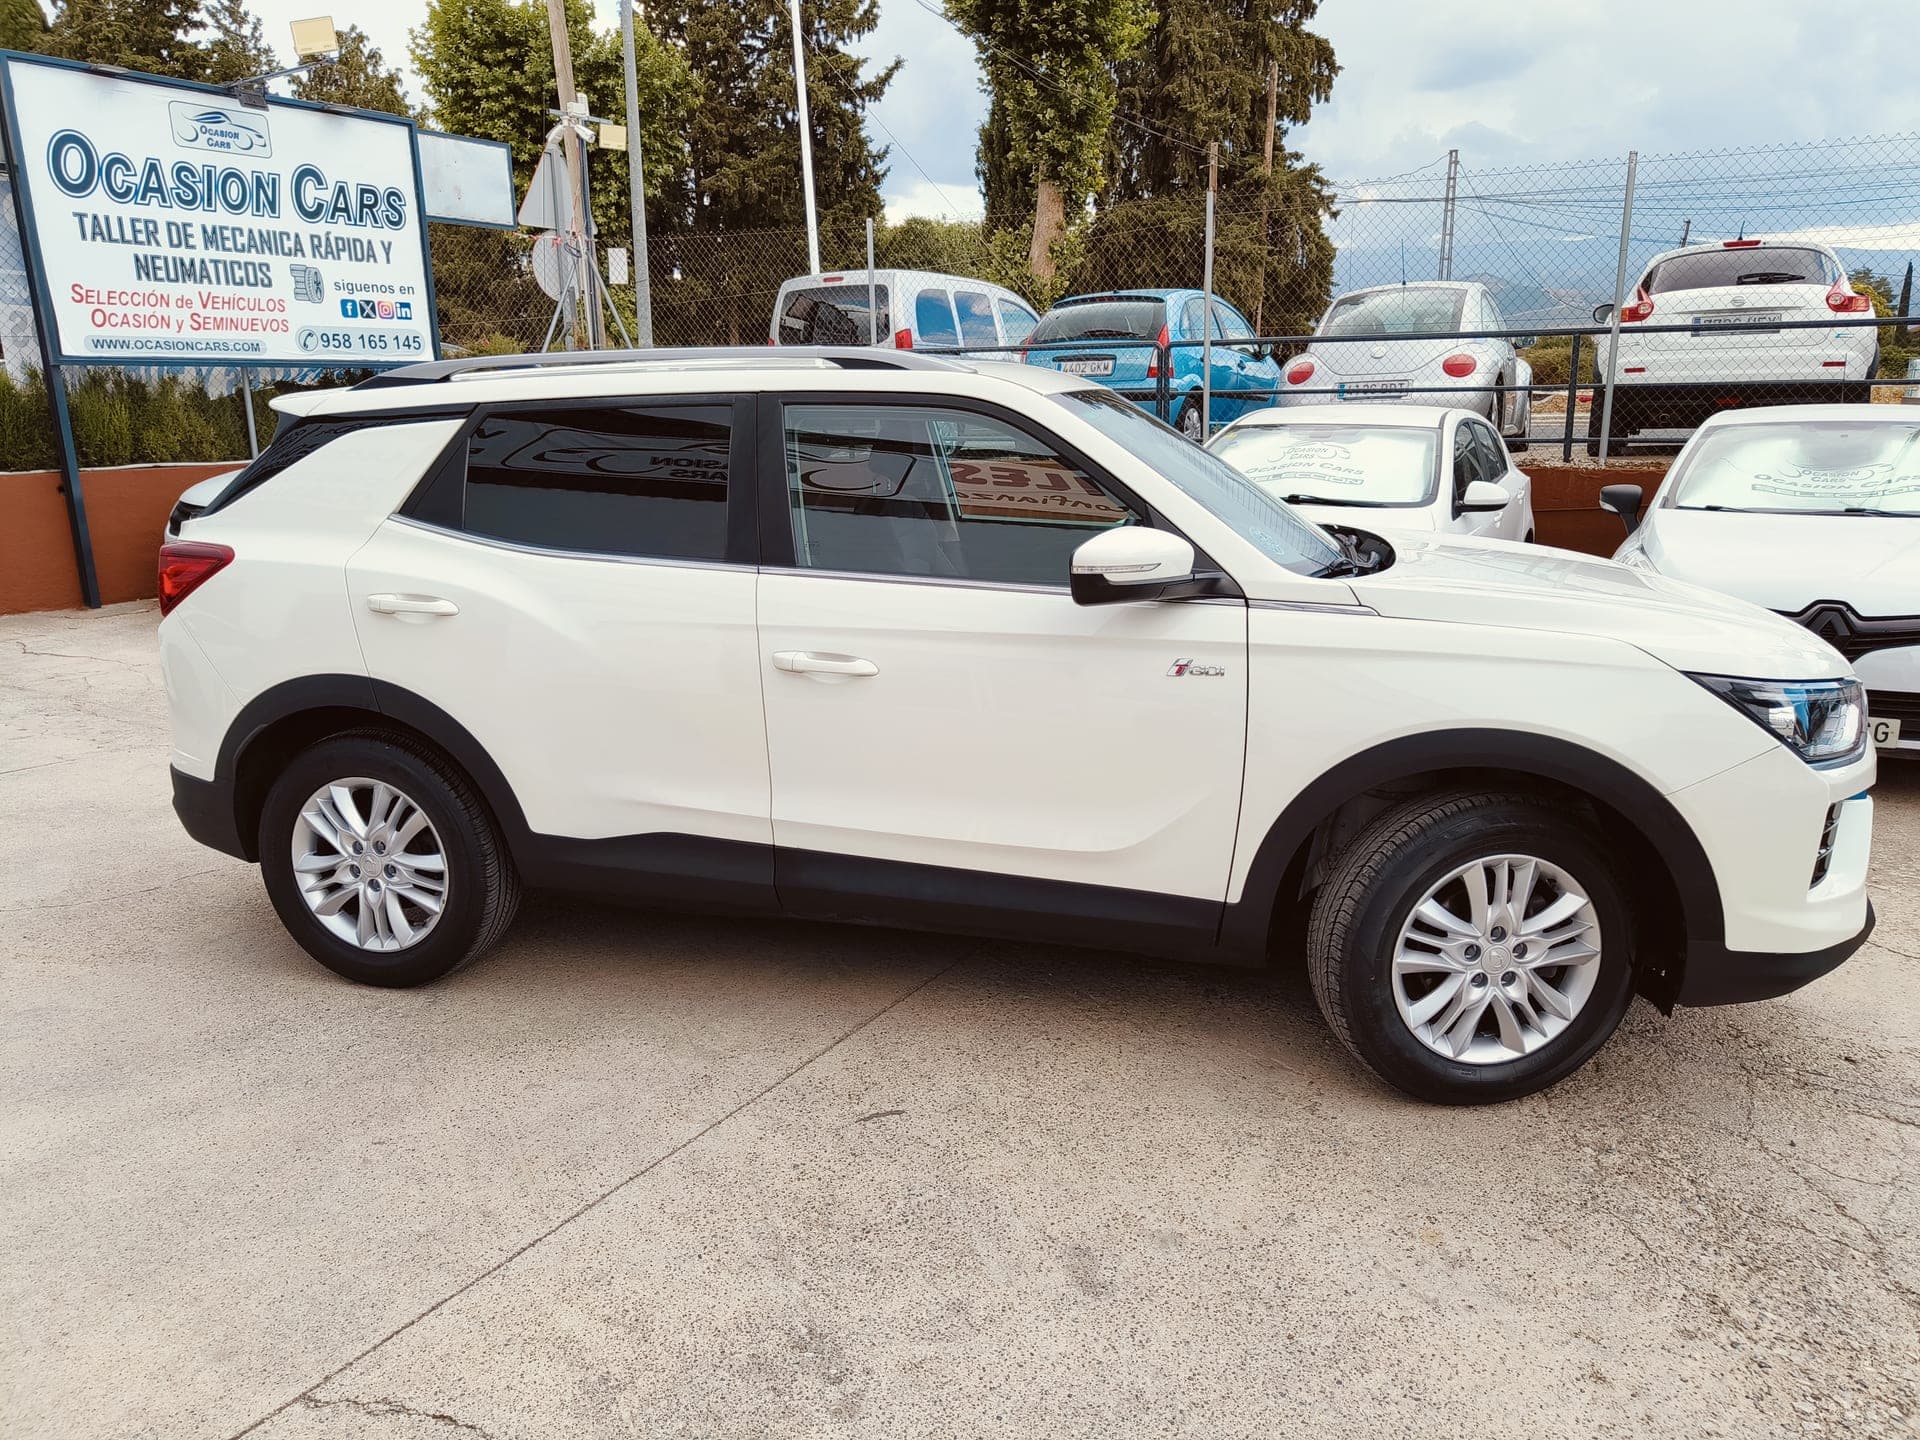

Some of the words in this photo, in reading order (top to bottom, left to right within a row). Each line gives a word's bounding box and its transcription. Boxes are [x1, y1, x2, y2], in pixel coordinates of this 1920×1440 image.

[200, 125, 239, 140] OCASION
[207, 138, 231, 149] CARS
[47, 128, 281, 218] OCASION
[291, 163, 407, 231] CARS
[72, 211, 161, 247] TALLER
[166, 221, 196, 250] DE
[201, 224, 307, 258] MECANICA
[310, 230, 378, 264] RÁPIDA
[380, 240, 393, 264] Y
[133, 253, 273, 288] NEUMATICOS
[71, 283, 170, 308] SELECCIÓN
[175, 294, 194, 309] de
[198, 291, 286, 312] VEHÍCULOS
[399, 284, 415, 296] en
[91, 308, 171, 329] OCASIÓN
[176, 318, 185, 333] y
[190, 312, 289, 332] SEMINUEVOS
[92, 338, 261, 352] WWW.OCASIONCARS.COM
[321, 333, 352, 349] 958
[359, 334, 387, 350] 165
[393, 335, 421, 350] 145
[1062, 363, 1087, 374] 4402
[1090, 361, 1110, 372] GKM
